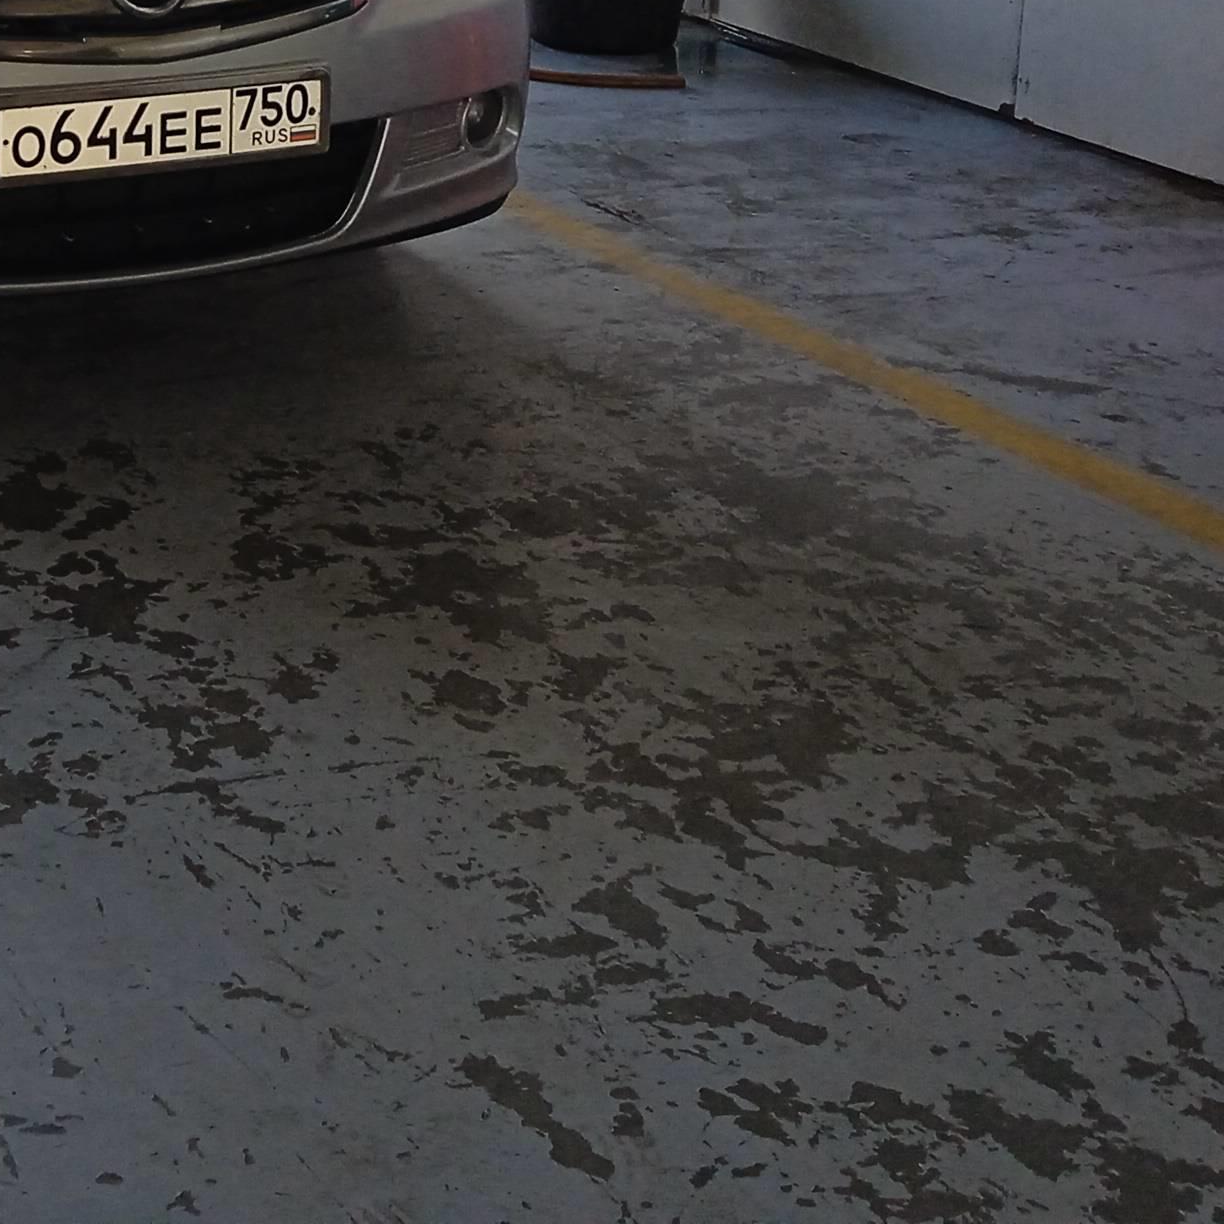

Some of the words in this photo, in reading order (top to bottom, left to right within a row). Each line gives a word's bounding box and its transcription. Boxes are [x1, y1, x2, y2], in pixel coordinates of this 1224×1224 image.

[11, 101, 222, 169] О644ЕЕ
[235, 84, 309, 131] 750
[251, 128, 289, 146] RUS
